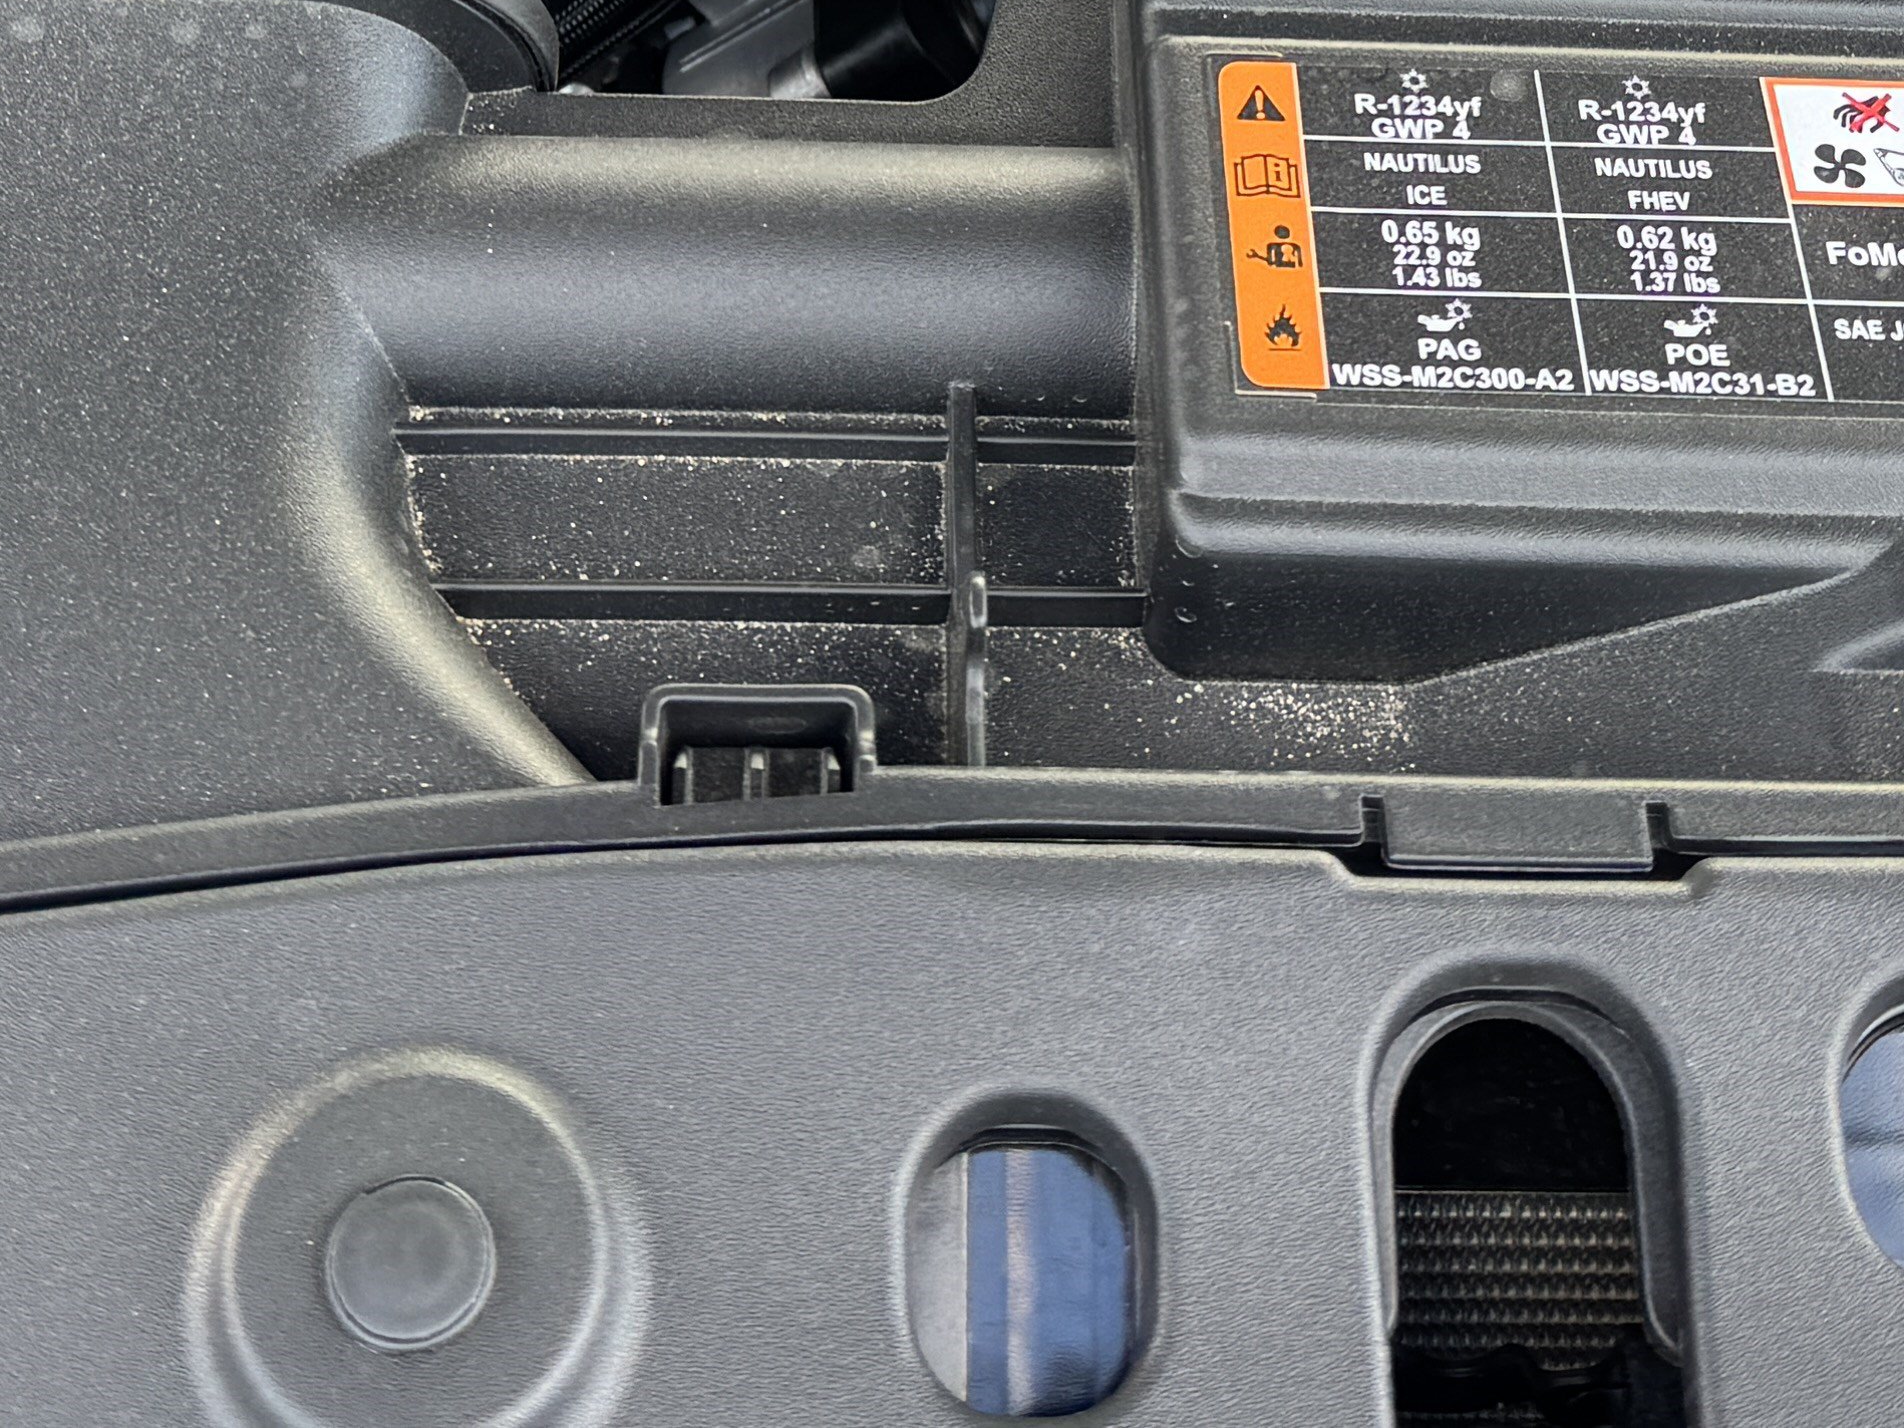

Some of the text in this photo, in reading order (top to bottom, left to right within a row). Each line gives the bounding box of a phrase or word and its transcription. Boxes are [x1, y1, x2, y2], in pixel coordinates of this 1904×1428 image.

[1353, 92, 1482, 125] R-1234yf
[1577, 96, 1706, 128] R-1234yf
[1369, 117, 1472, 140] GWP 4
[1594, 122, 1697, 146] GWP 4
[1363, 151, 1482, 174] NAUTILUS
[1593, 157, 1713, 180] NAUTILUS
[1405, 184, 1448, 206] ICE
[1627, 189, 1691, 213] FHEV
[1381, 219, 1481, 254] 0.65 kg
[1616, 224, 1718, 259] 0.62 kg
[1392, 243, 1480, 267] 22.9 oz
[1629, 249, 1716, 274] 21.9 oz
[1391, 265, 1483, 289] 1.43 lbs
[1629, 270, 1721, 294] 1.37 lbs
[1833, 315, 1886, 341] SAE
[1417, 337, 1482, 362] PAG
[1664, 342, 1731, 367] POE
[1332, 365, 1575, 393] WSS-M2C300-A2
[1589, 368, 1817, 396] WSS-M2C31-B2
